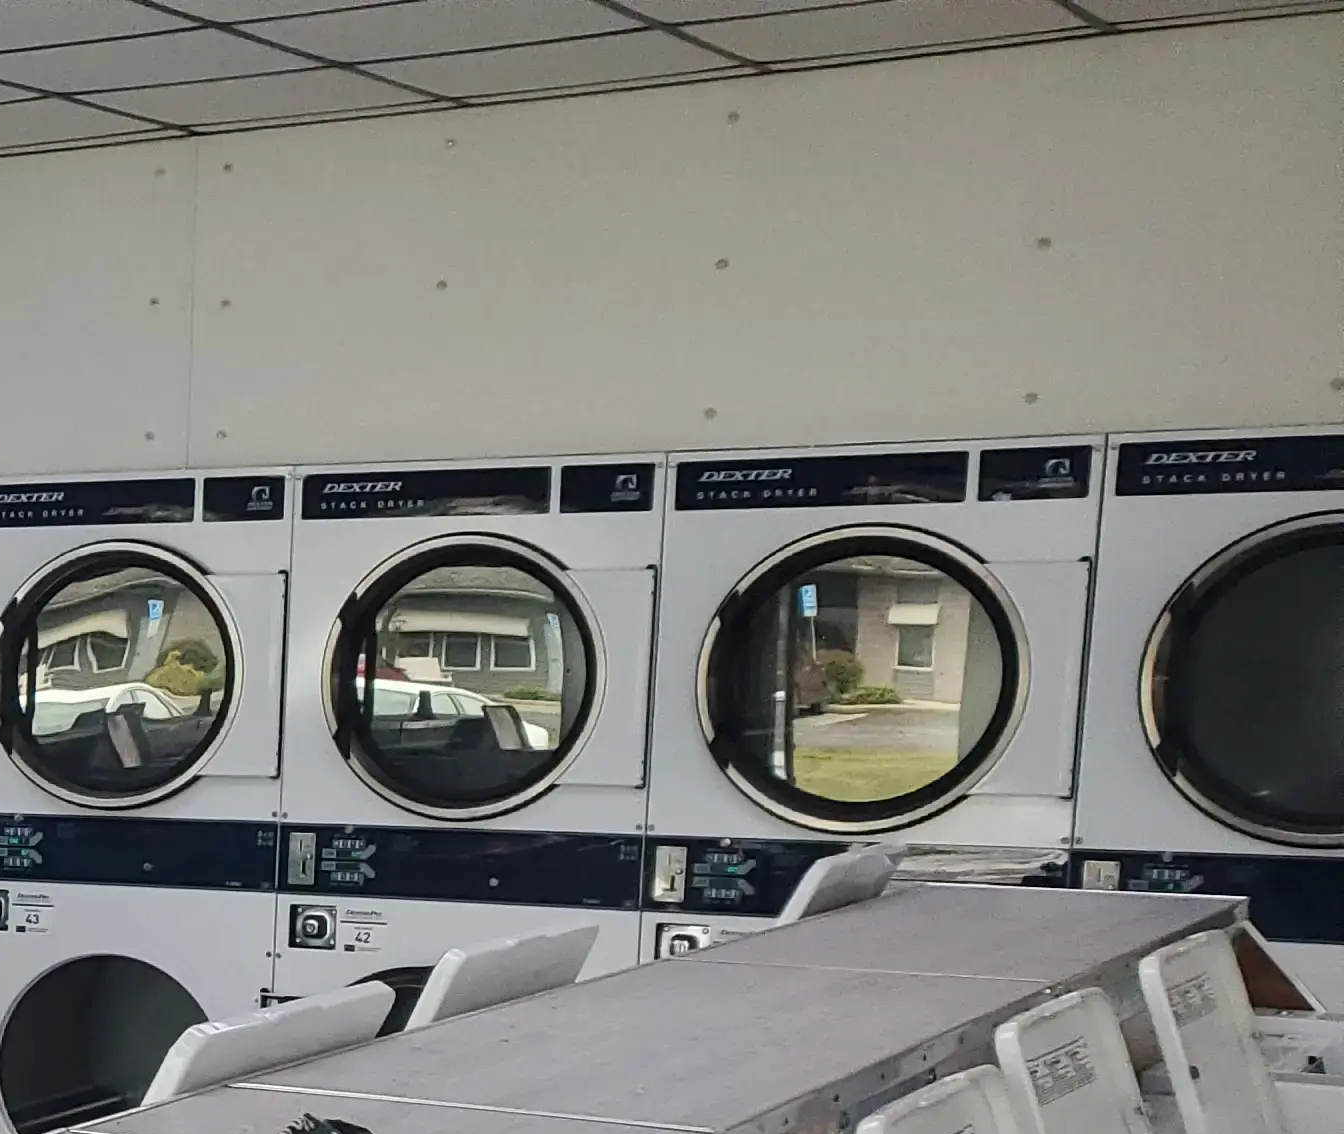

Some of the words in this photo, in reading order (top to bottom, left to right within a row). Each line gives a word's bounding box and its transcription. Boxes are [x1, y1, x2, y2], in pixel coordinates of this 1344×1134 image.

[1144, 450, 1257, 465] DEXTER
[698, 468, 793, 482] DEXTER
[1141, 474, 1207, 484] STACK
[1221, 471, 1287, 481] DRYER
[321, 481, 403, 494] DEXTER
[320, 501, 367, 510] STACK
[377, 499, 425, 509] DRYER
[25, 913, 40, 925] 43
[354, 931, 372, 944] 42
